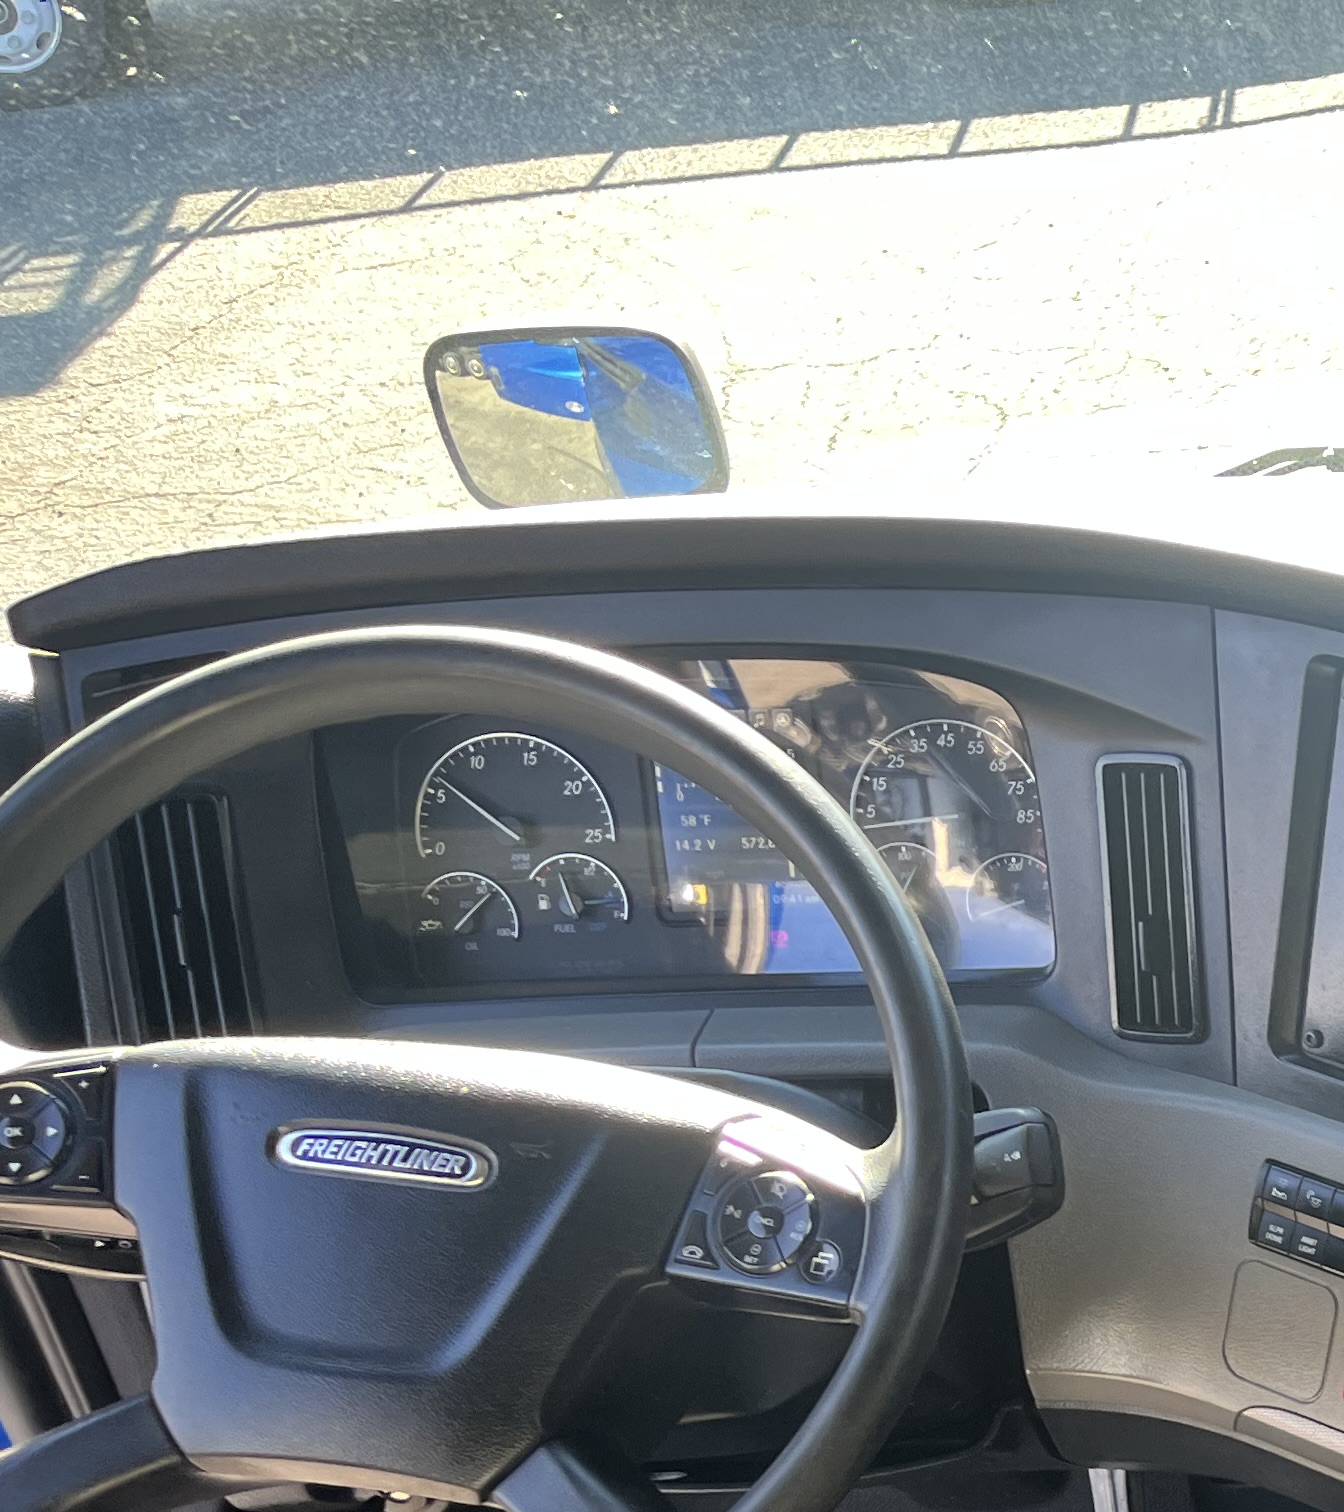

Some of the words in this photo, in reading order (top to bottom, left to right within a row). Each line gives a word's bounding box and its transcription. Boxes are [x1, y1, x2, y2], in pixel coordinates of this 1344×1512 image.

[909, 739, 928, 753] 35
[936, 734, 955, 747] 45
[967, 741, 985, 755] 55
[470, 755, 484, 770] 10
[523, 752, 537, 765] 15
[887, 755, 905, 768] 25
[989, 759, 1007, 772] 65
[564, 780, 582, 795] 20
[872, 777, 887, 791] 15
[1007, 782, 1025, 795] 75
[437, 789, 446, 803] 5
[866, 804, 876, 819] 5
[1016, 810, 1035, 824] 85
[680, 815, 697, 827] 58
[585, 829, 602, 843] 25
[435, 842, 446, 855] 0
[675, 840, 702, 851] 14.2
[707, 840, 716, 850] V
[3, 1126, 24, 1137] OK
[296, 1138, 466, 1175] FREIGHTLINER
